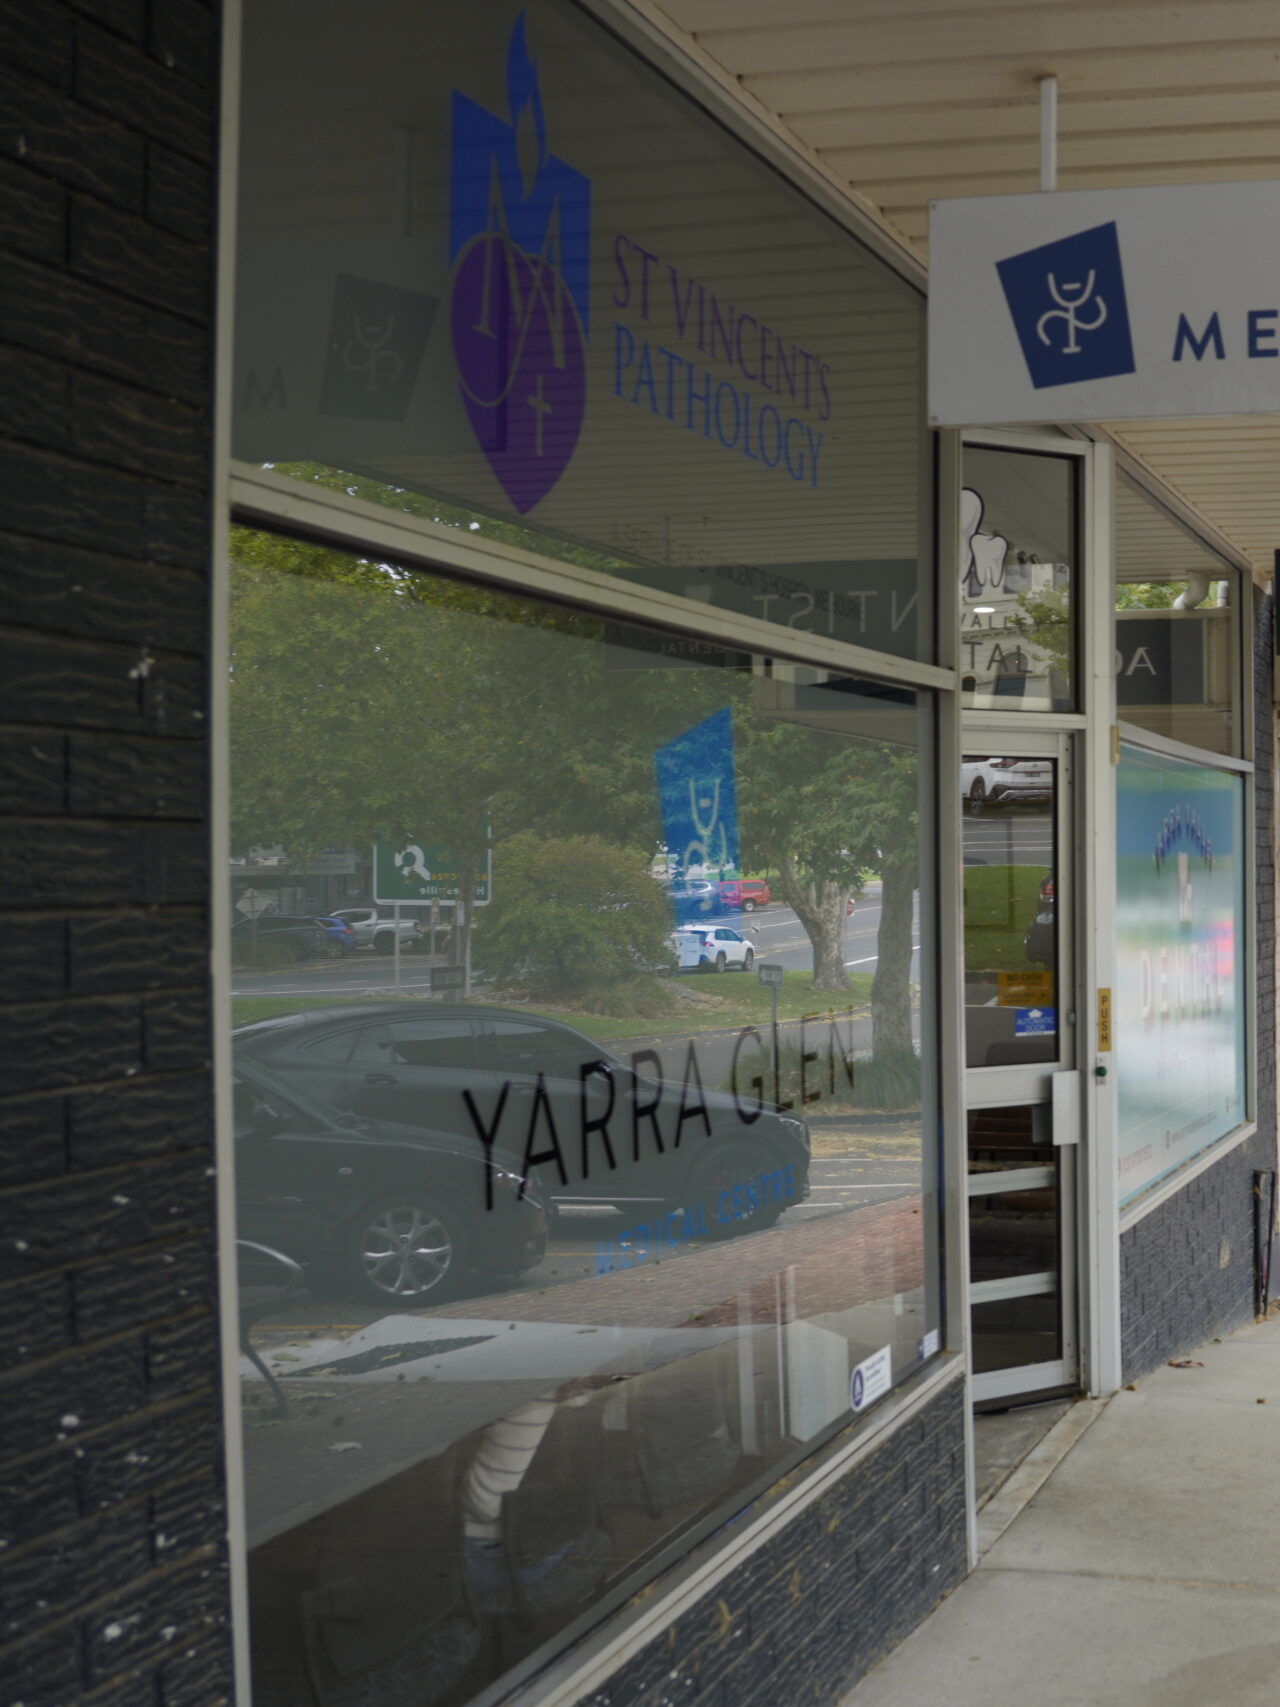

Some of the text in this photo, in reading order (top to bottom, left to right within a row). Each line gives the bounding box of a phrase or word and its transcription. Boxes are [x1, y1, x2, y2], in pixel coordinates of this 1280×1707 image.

[612, 233, 659, 321] ST
[613, 321, 824, 488] PATHOLOGY
[1101, 995, 1109, 1044] PUSH
[462, 1006, 855, 1212] YARRA GLEN
[594, 1163, 795, 1279] MEDICAL CENTRE
